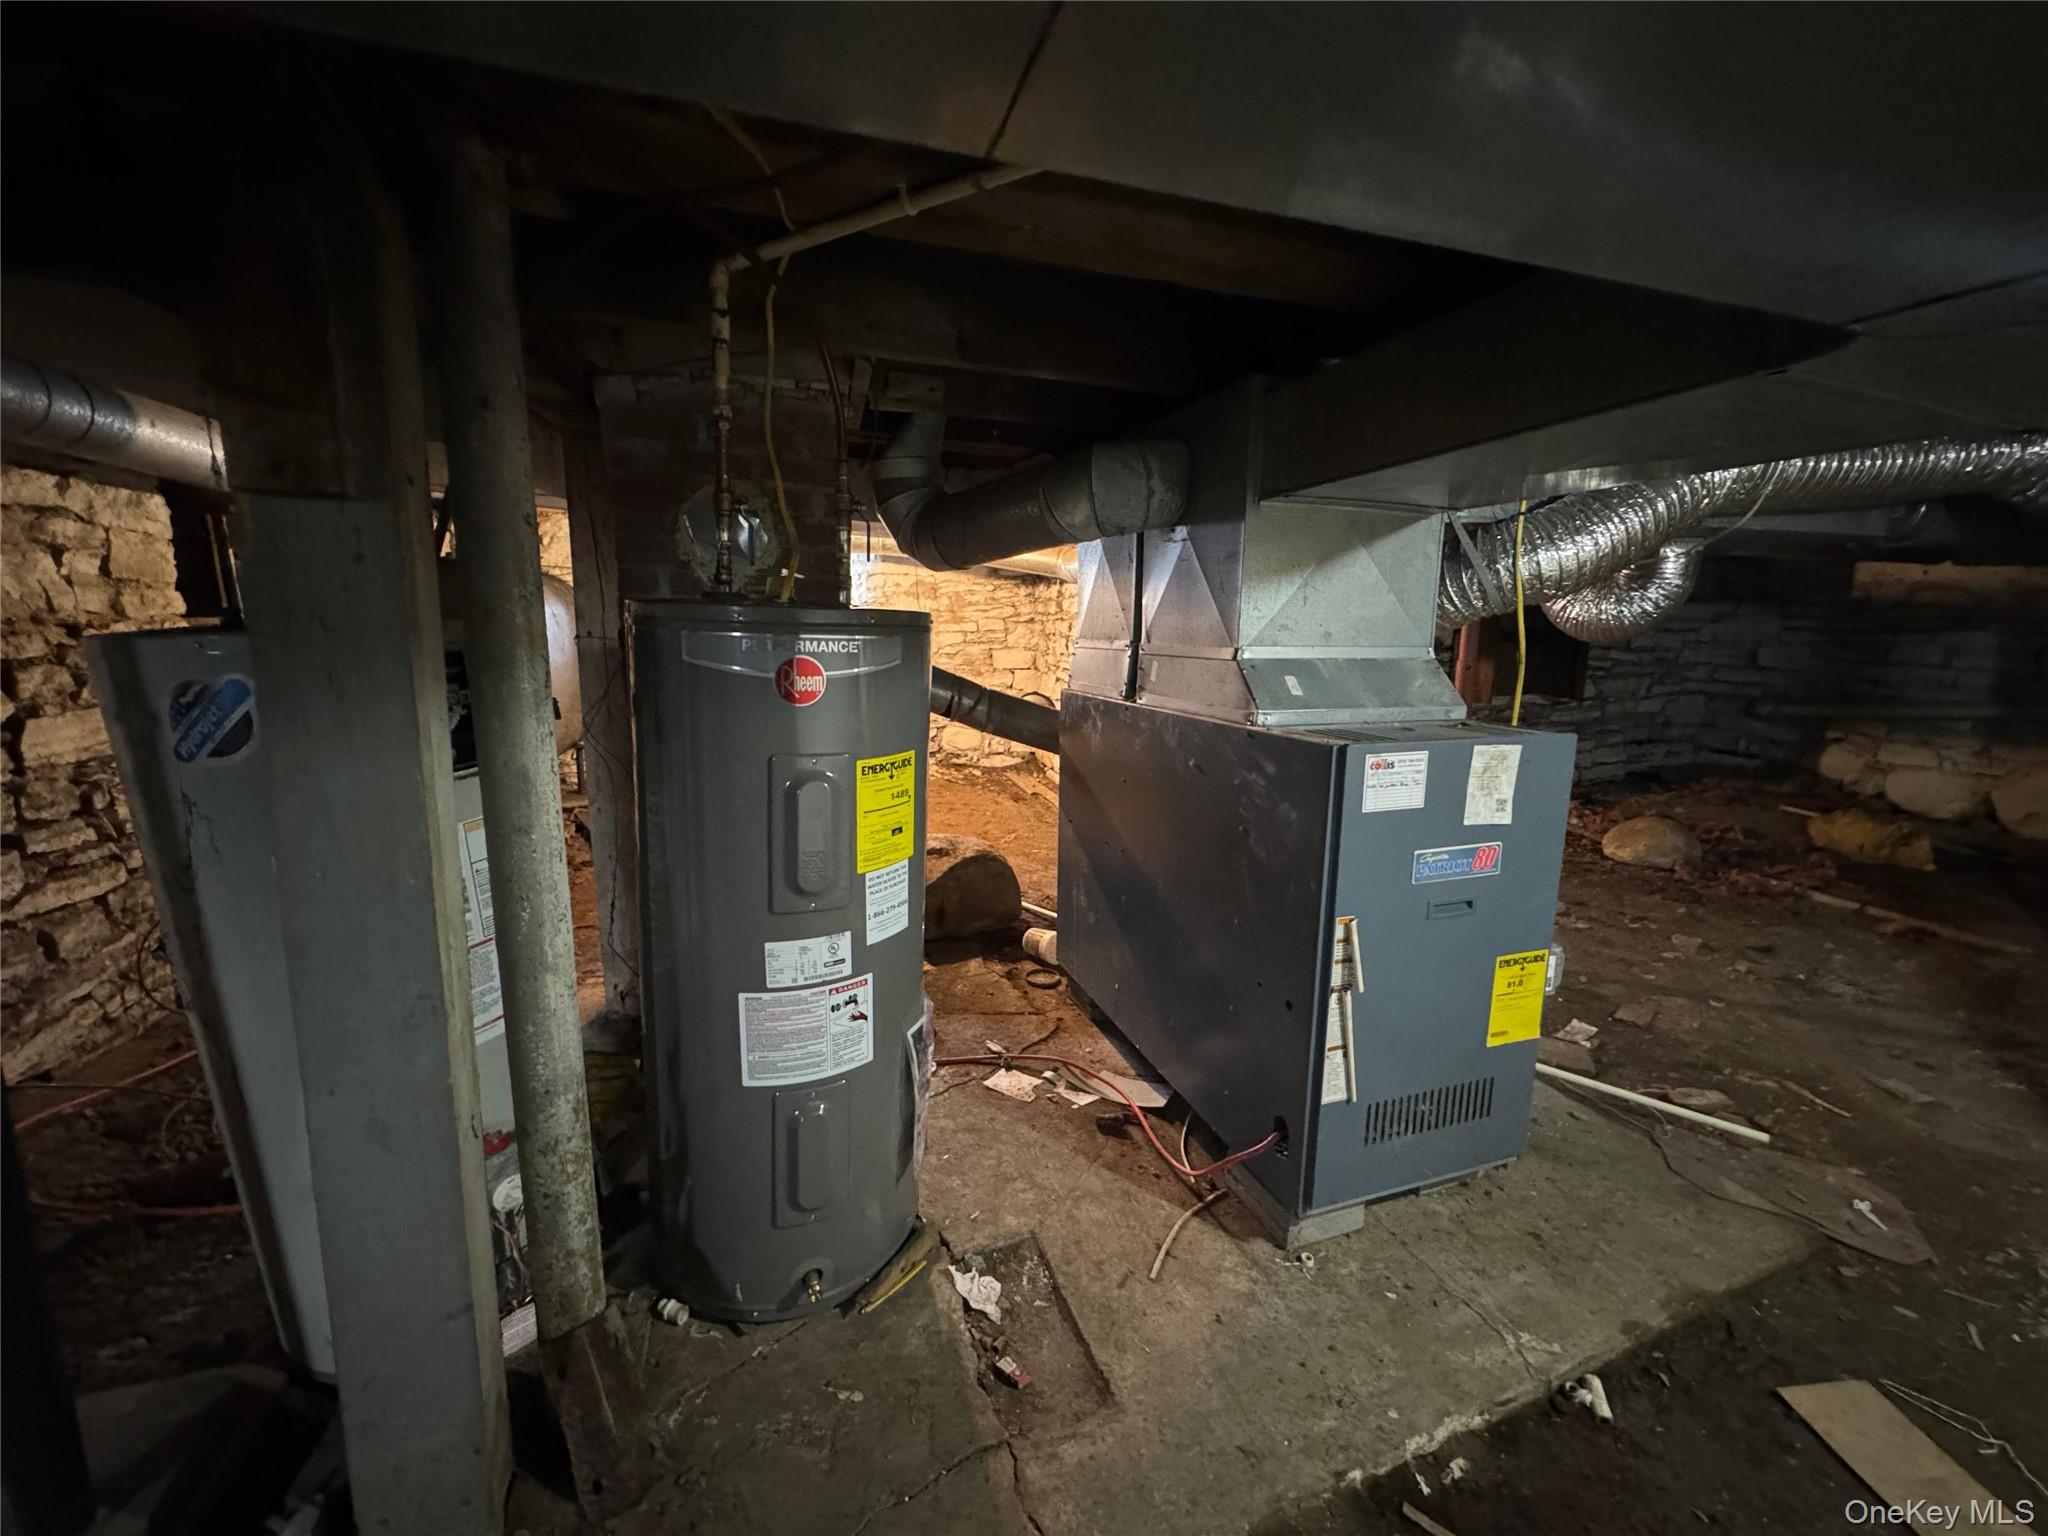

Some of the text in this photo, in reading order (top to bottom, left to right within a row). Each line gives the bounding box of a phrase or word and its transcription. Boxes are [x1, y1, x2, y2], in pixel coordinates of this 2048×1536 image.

[742, 639, 859, 653] PERMANCE
[780, 659, 823, 698] Rheem
[1472, 846, 1499, 872] 80
